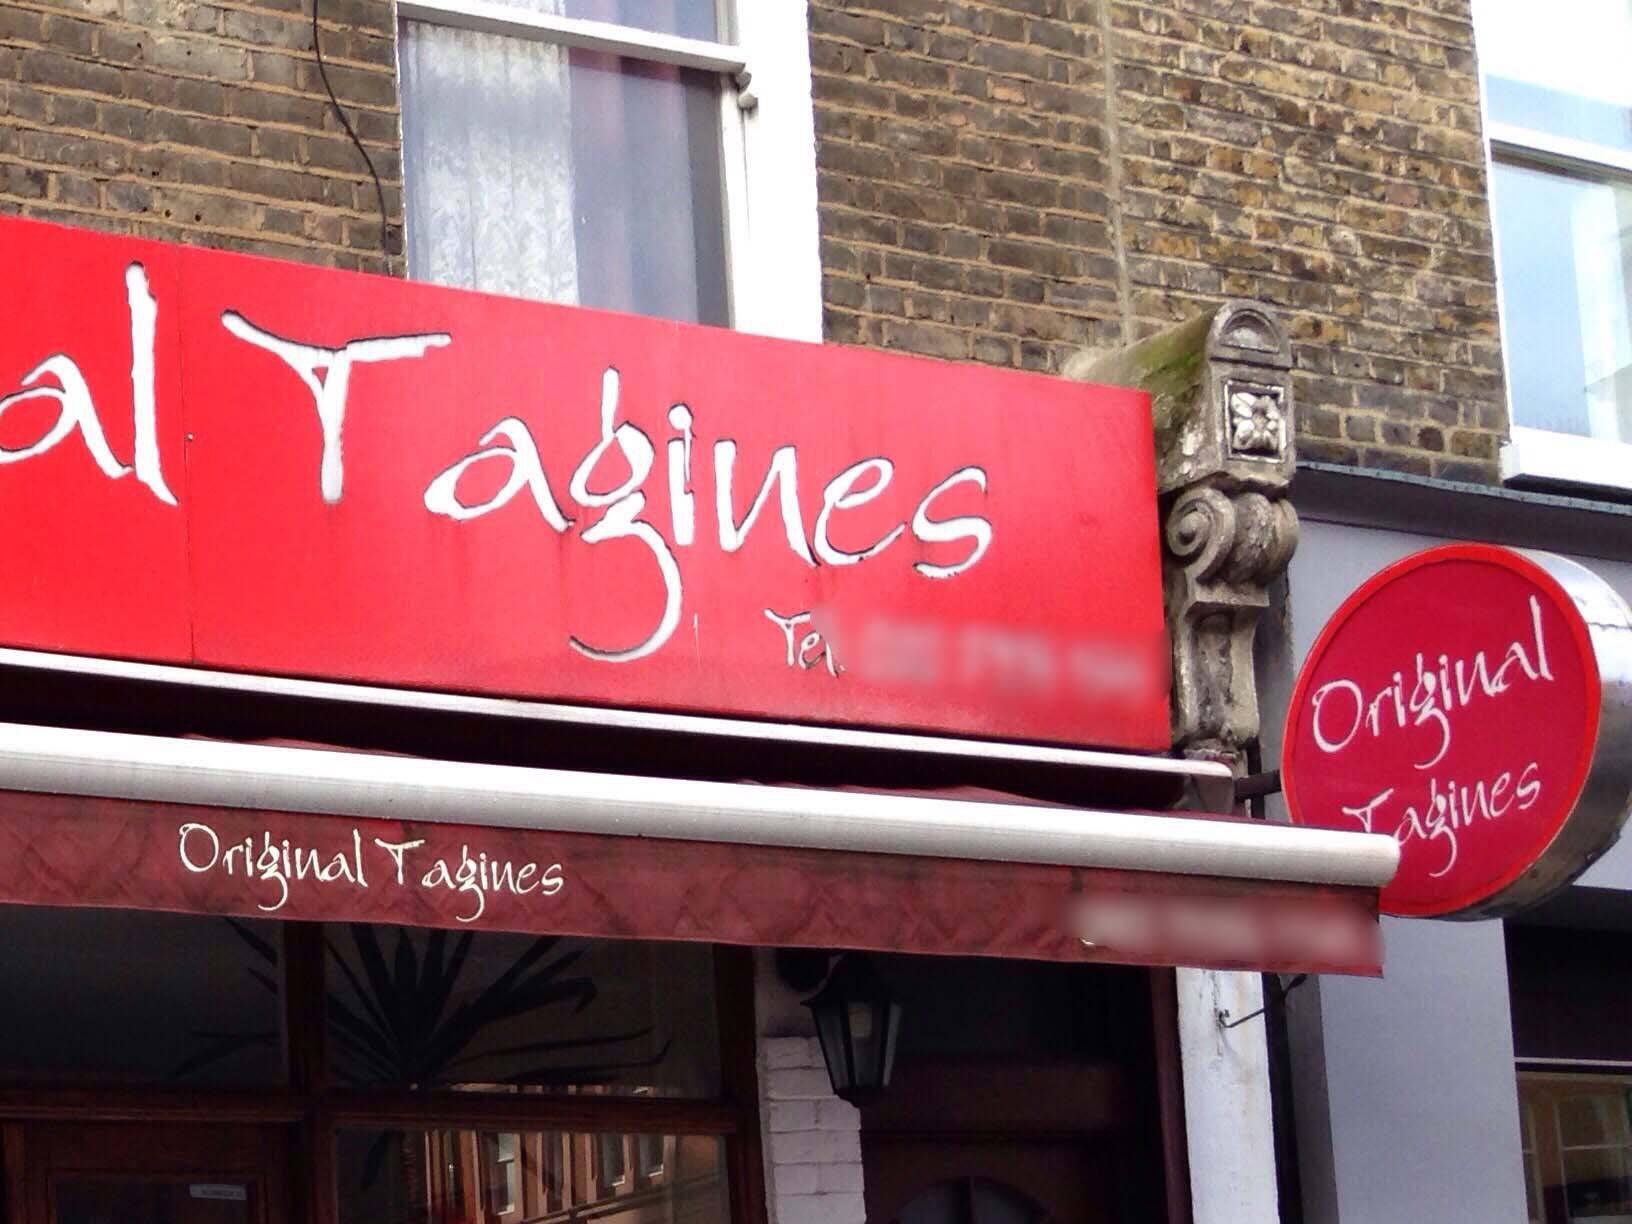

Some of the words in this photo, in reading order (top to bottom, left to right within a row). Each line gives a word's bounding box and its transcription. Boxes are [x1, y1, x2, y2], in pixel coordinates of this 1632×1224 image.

[220, 308, 994, 663] Tagines
[1311, 594, 1554, 770] Original
[178, 821, 369, 912] Original
[374, 837, 565, 923] Tagines
[1342, 761, 1542, 878] Tagines
